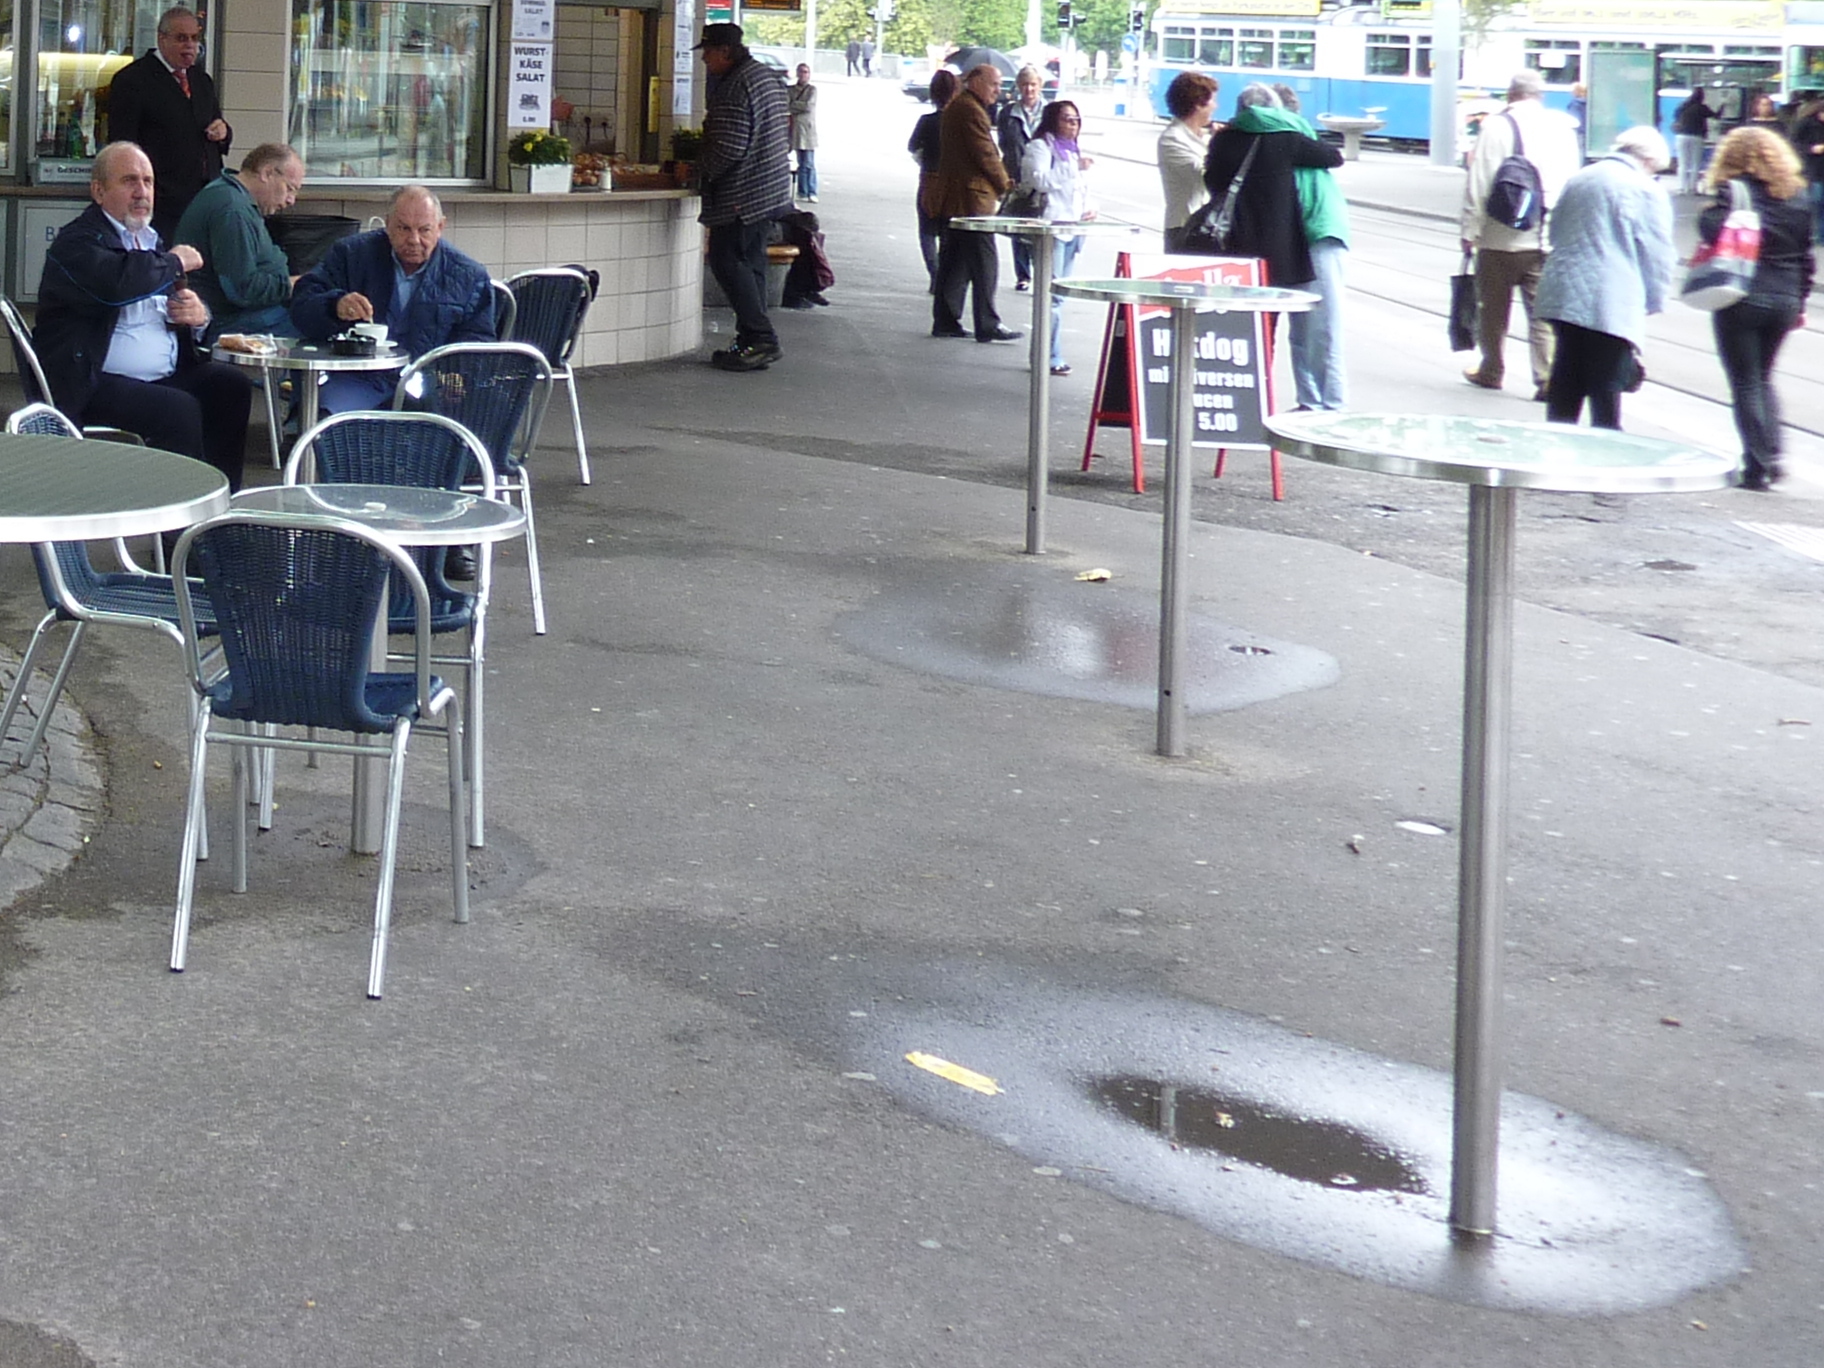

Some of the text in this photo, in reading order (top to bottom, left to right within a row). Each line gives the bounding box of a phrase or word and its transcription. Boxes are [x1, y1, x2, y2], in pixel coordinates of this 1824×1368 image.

[519, 58, 543, 69] KÄSE
[515, 73, 545, 82] SALAT
[1152, 328, 1249, 366] Hdog
[1193, 368, 1255, 388] iversen
[1193, 393, 1234, 409] ucen
[1198, 412, 1238, 431] 5.00
